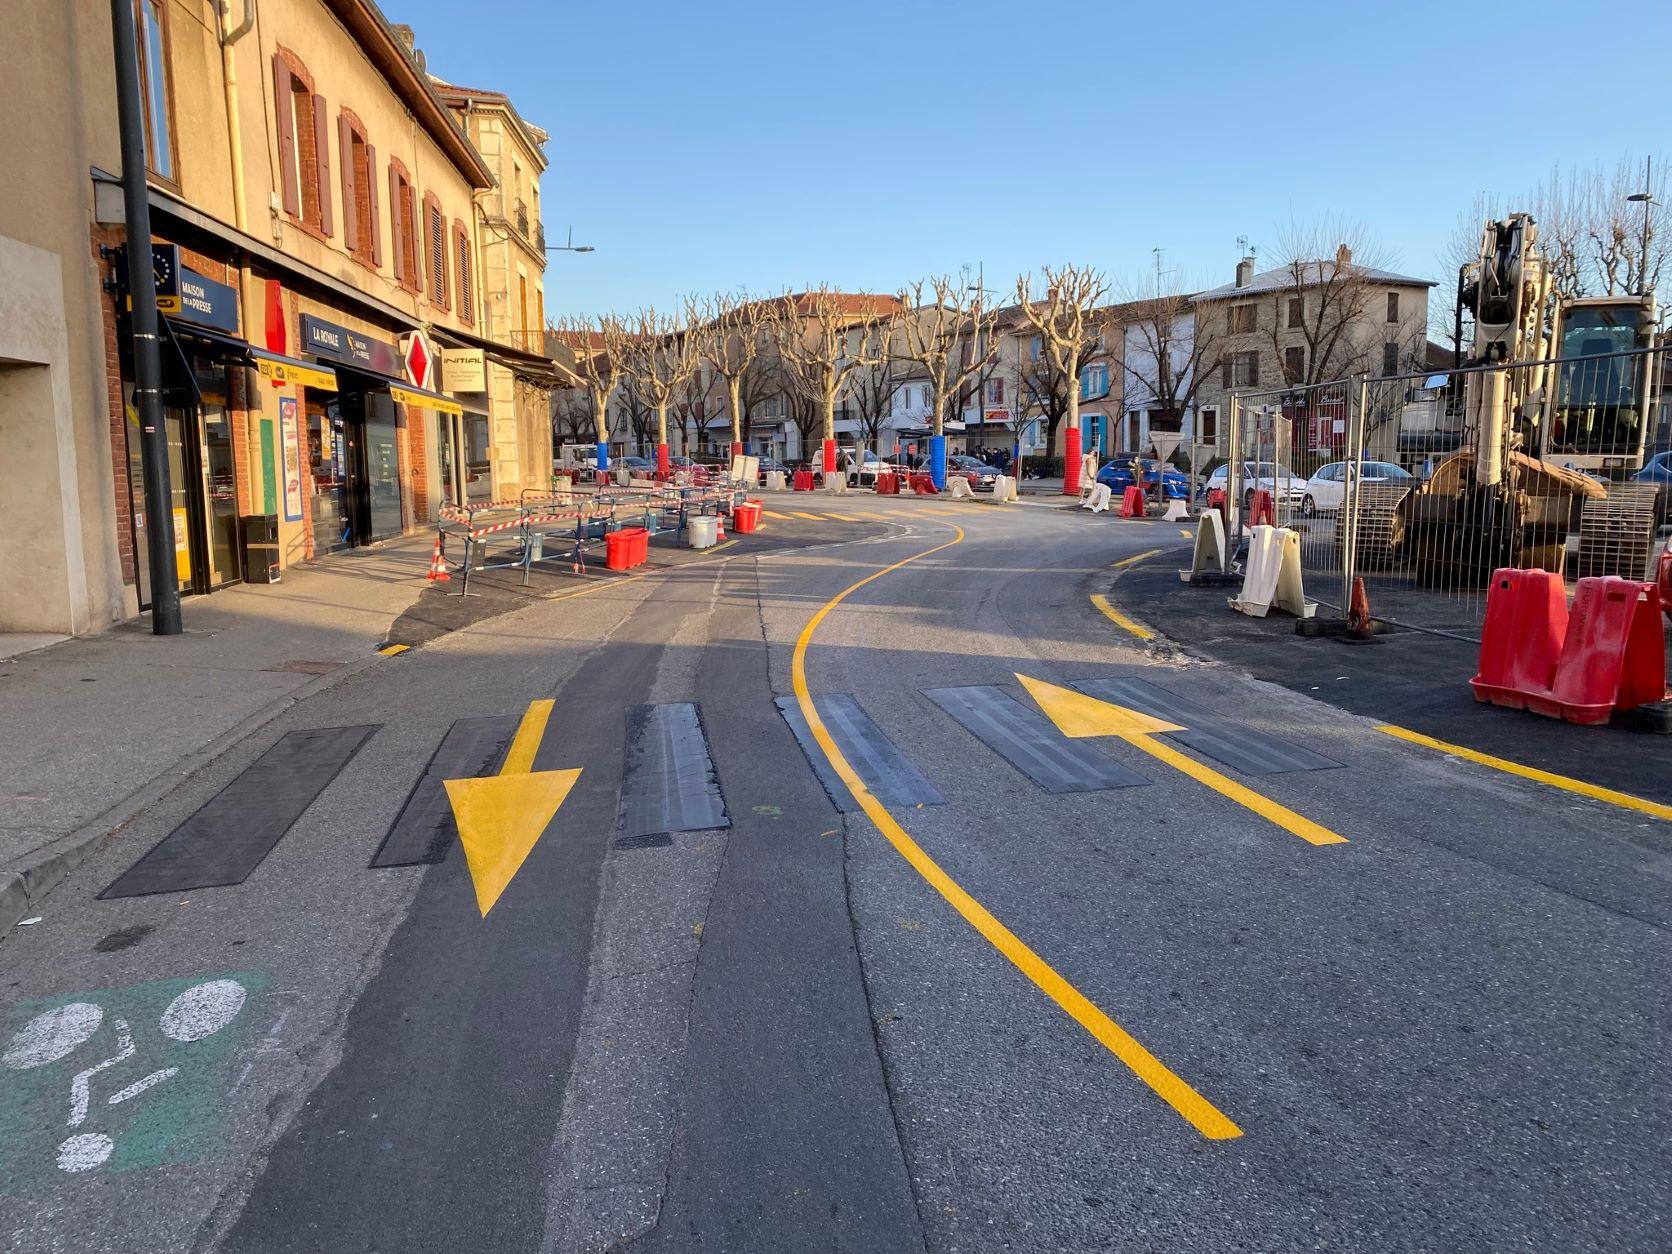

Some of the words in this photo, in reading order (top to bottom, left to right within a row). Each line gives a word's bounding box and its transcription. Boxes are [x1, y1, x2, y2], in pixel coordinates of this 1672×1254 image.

[182, 281, 204, 299] MAISON
[193, 299, 211, 314] PRESSE
[313, 327, 321, 341] LA
[321, 330, 339, 347] ROYALE
